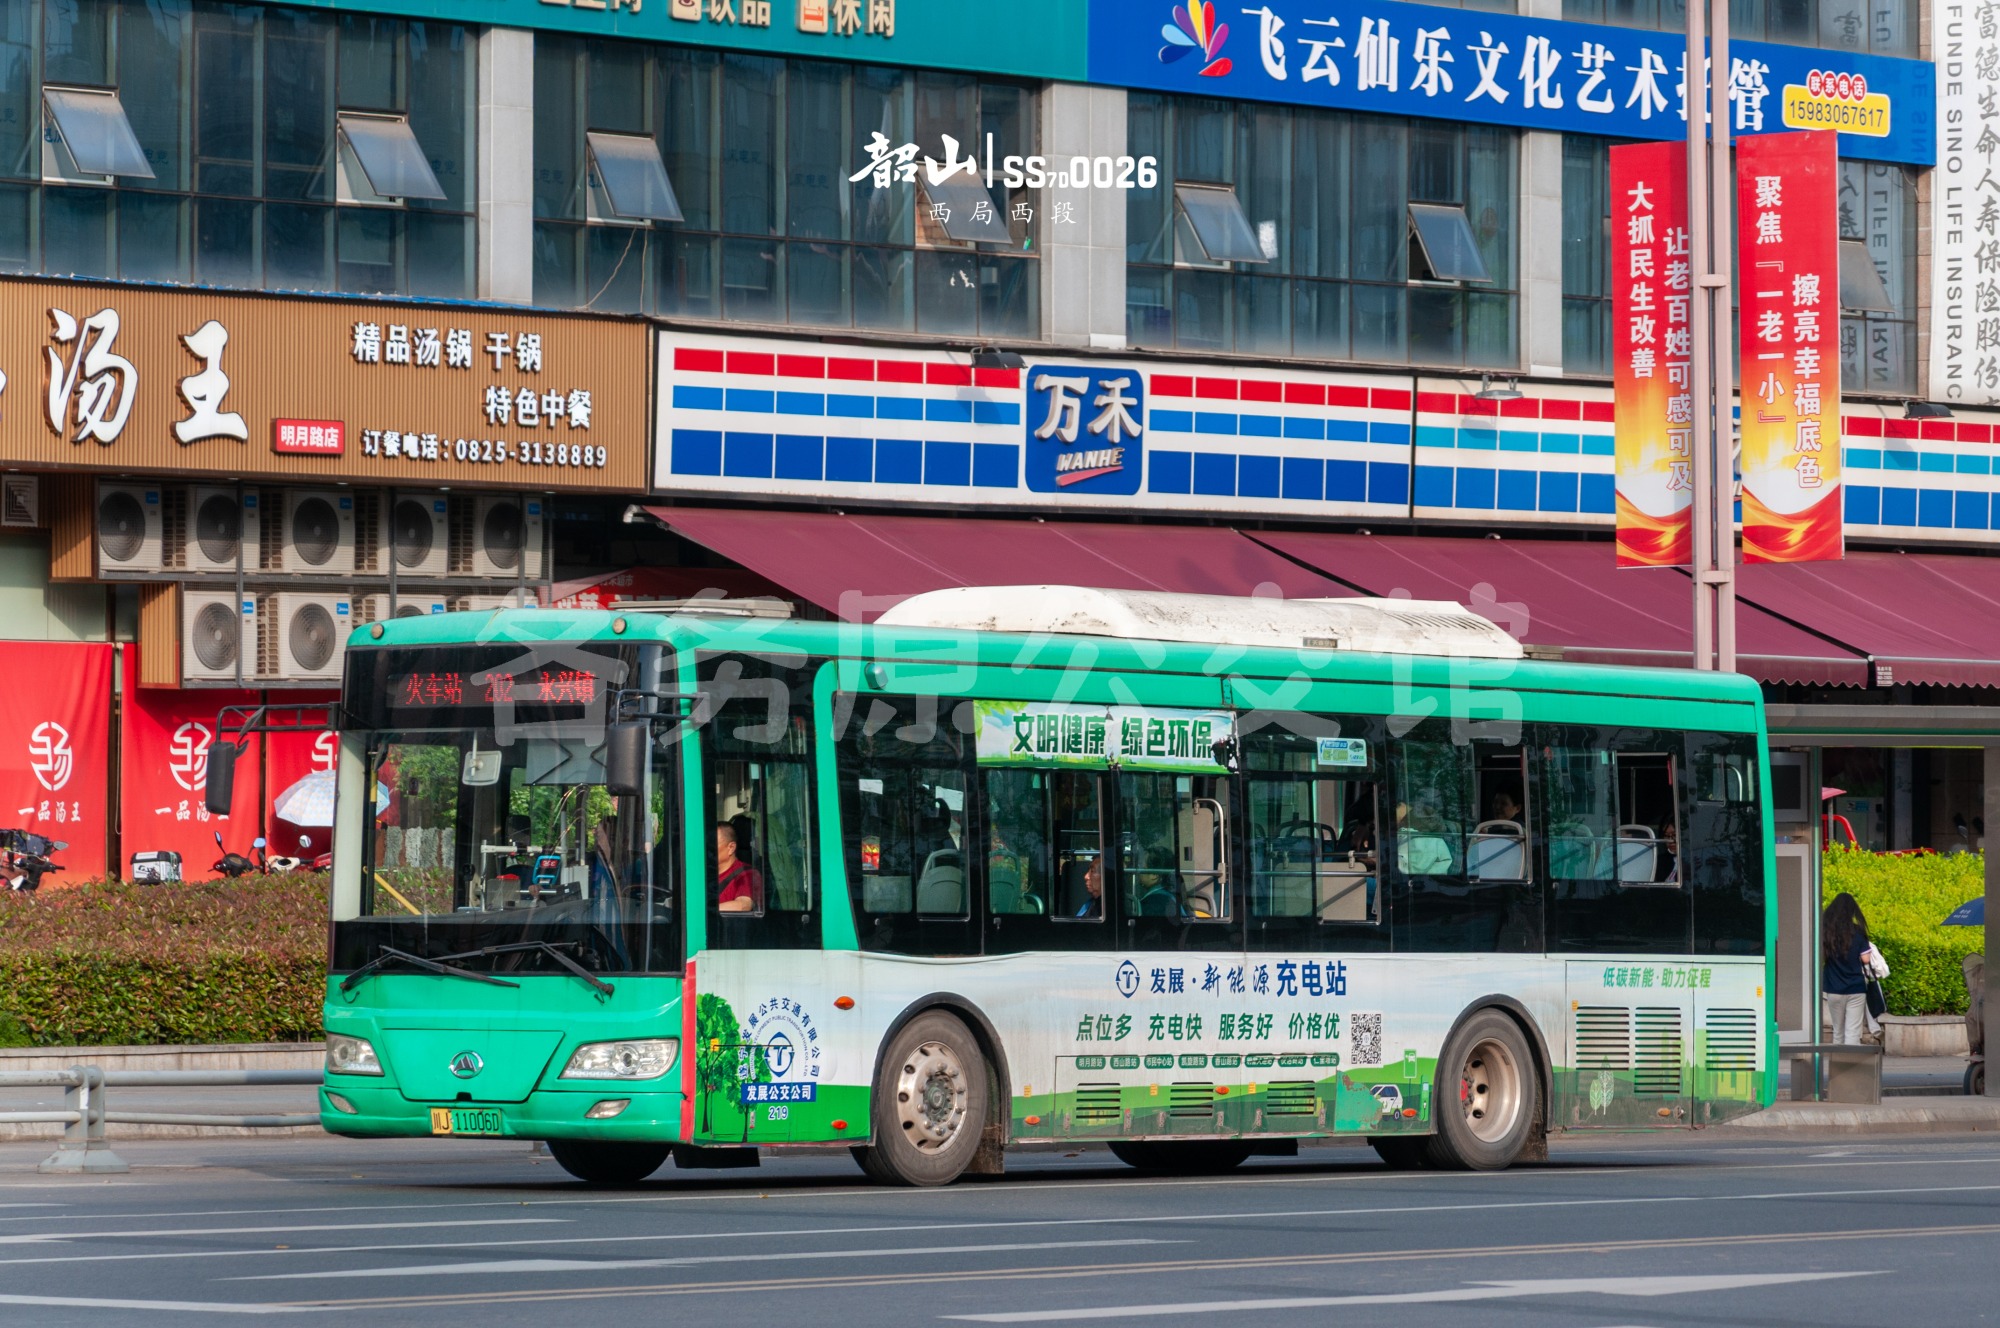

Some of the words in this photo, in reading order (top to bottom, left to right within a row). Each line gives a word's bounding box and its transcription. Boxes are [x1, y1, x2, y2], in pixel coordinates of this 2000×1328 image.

[833, 0, 894, 37] 休闲
[1947, 5, 1963, 97] FUNDE
[1810, 75, 1865, 99] 联系电话
[1790, 100, 1884, 128] 15983067617
[1947, 109, 1963, 174] SINO
[1947, 186, 1963, 245] LIFE
[1627, 181, 1657, 379] 大抓民生改善
[353, 321, 472, 369] 精品汤锅
[484, 332, 542, 372] 干锅
[1947, 257, 1963, 403] INSURANC
[0, 307, 249, 444] 汤王
[1662, 227, 1692, 491] 让老百姓可感可及
[1792, 273, 1823, 488] 擦亮幸福底色
[484, 385, 593, 430] 特色中餐
[1034, 374, 1143, 444] 万禾
[280, 425, 339, 449] 明月路店
[1056, 447, 1126, 472] WANHE
[405, 672, 462, 704] 火车站
[537, 671, 596, 704] 永兴镇
[1012, 712, 1106, 755] 文明健康
[1121, 715, 1213, 759] 绿色环保
[17, 800, 82, 824] 一品汤王
[154, 800, 230, 821] 一品汤
[1602, 967, 1712, 989] 低碳新能·助力征程
[1075, 1012, 1133, 1042] 点位多
[1146, 1012, 1203, 1042] 充电快
[1217, 1012, 1274, 1041] 服务好
[1287, 1011, 1340, 1041] 价格优
[746, 1084, 812, 1101] 发展公交公司
[768, 1105, 788, 1120] 219
